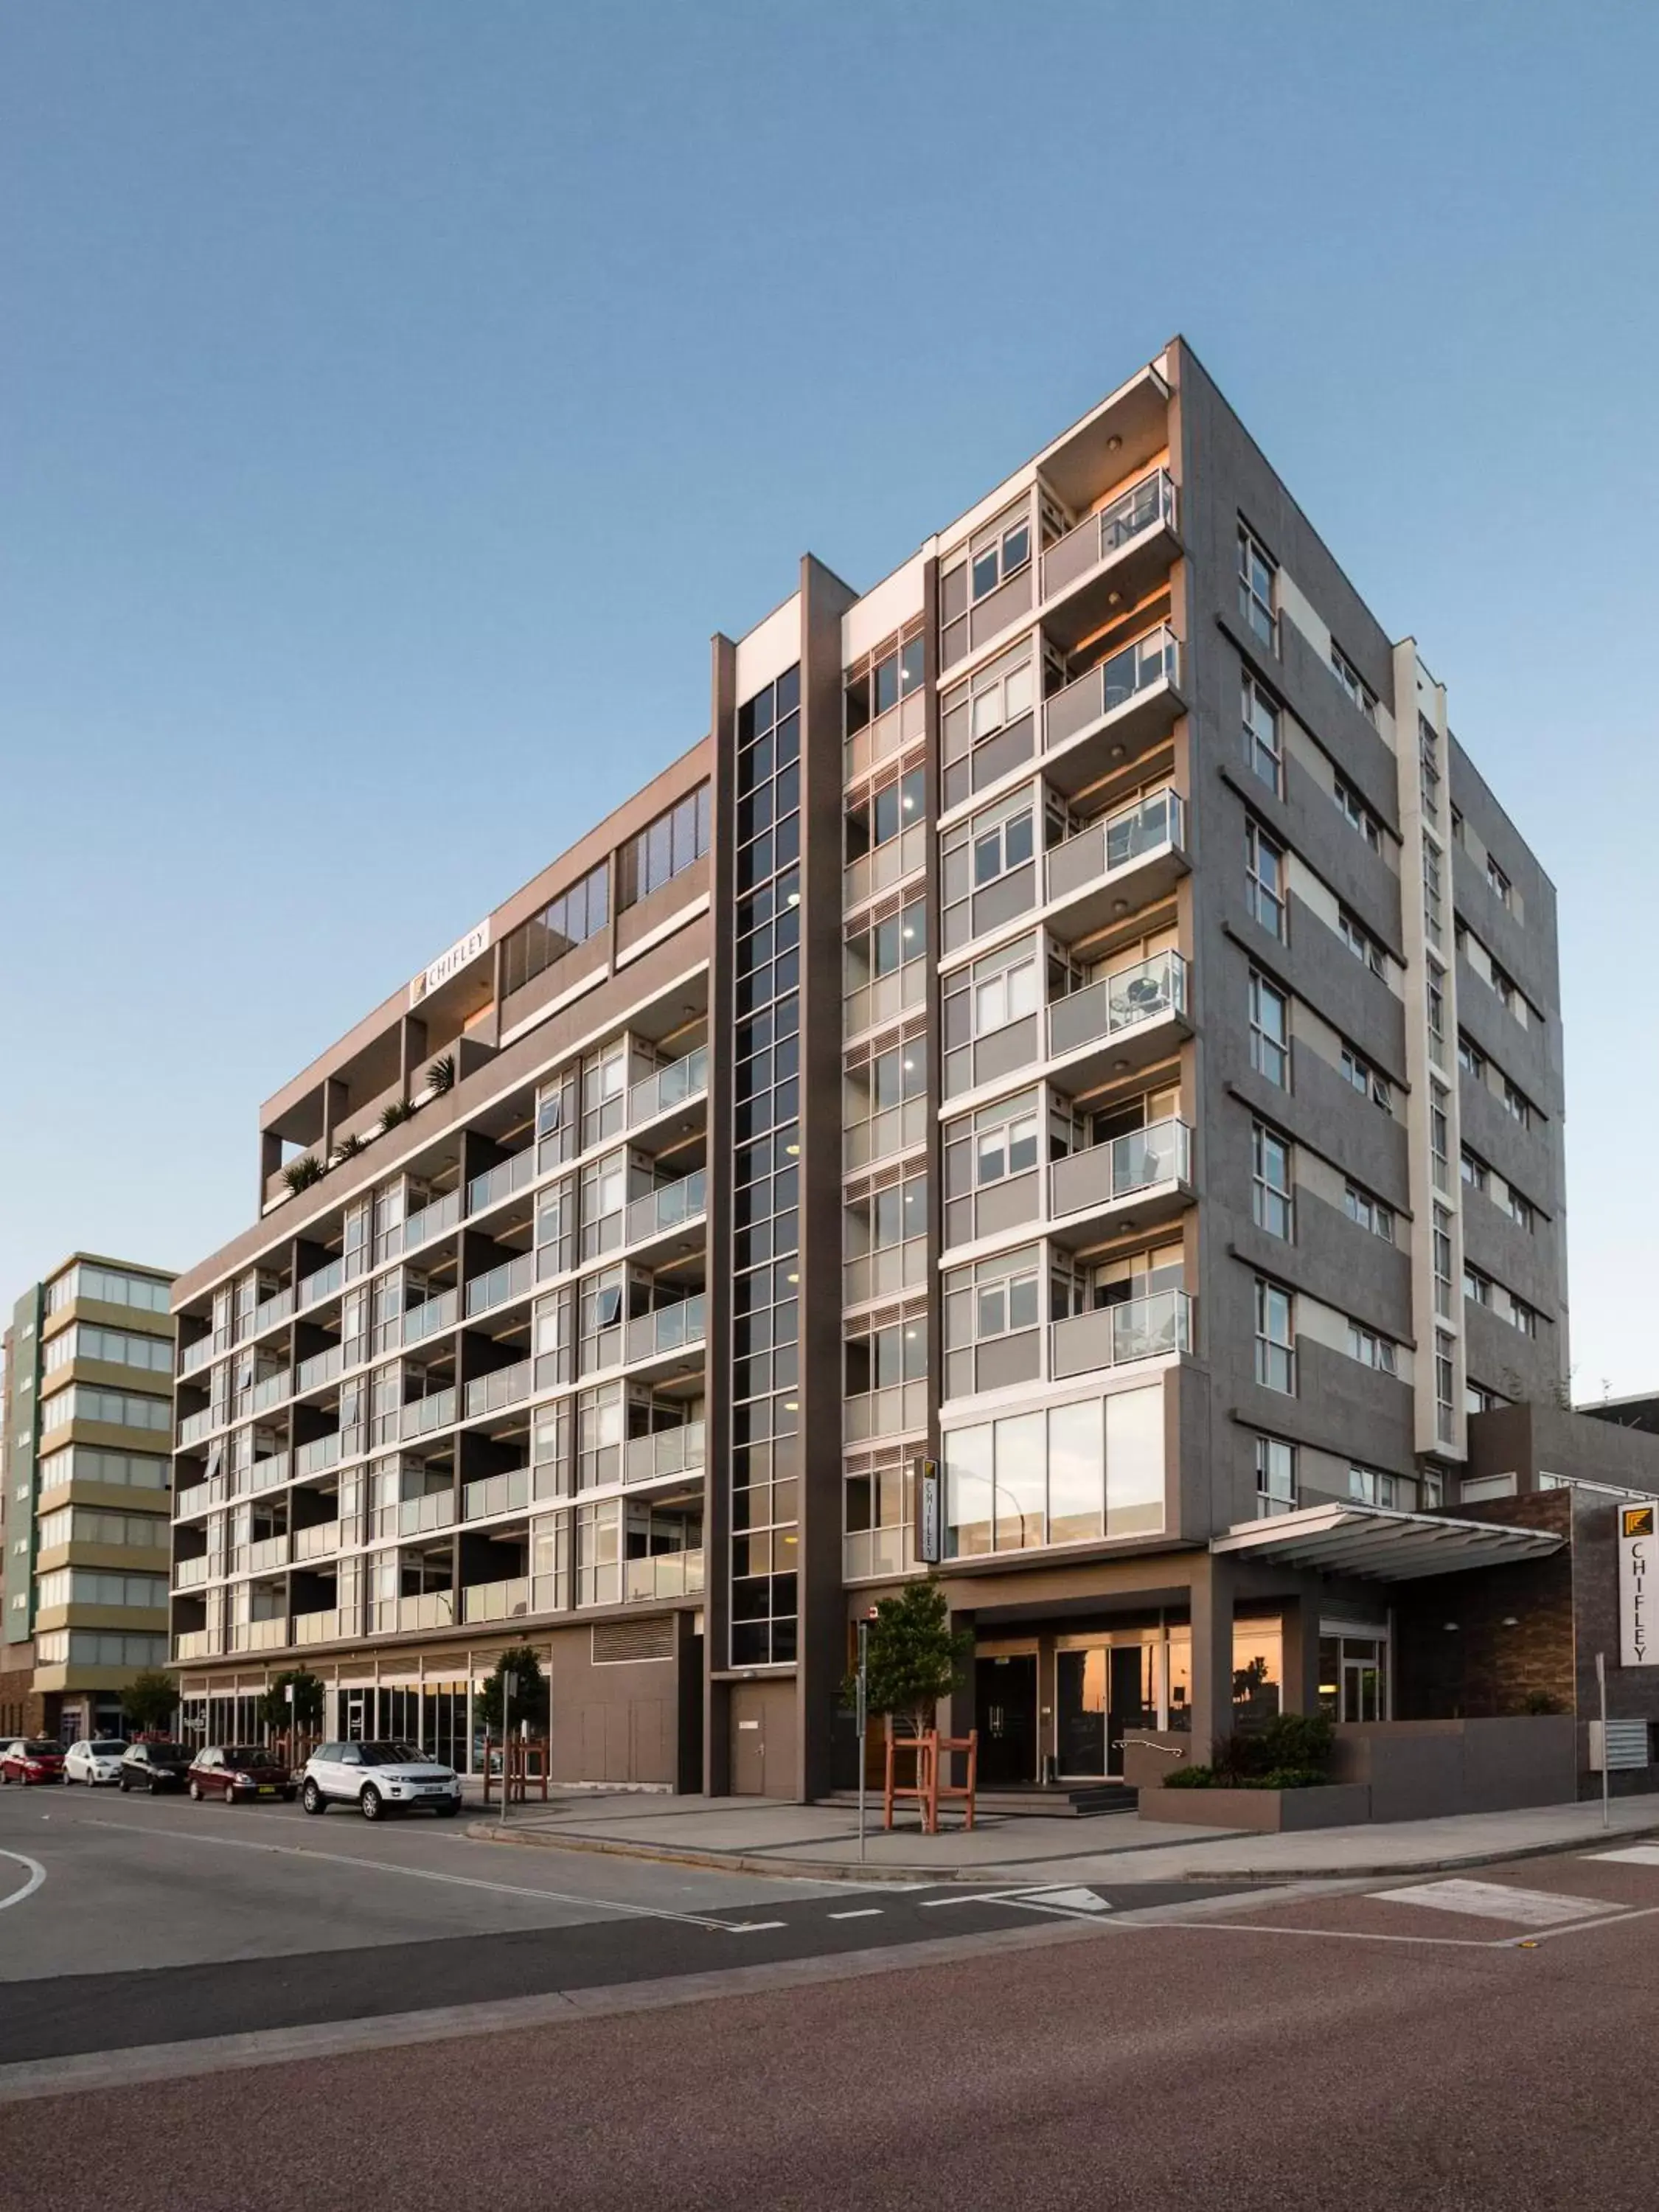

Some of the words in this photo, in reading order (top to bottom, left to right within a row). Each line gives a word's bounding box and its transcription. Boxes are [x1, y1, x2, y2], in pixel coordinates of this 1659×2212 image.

[429, 931, 484, 985] CHIFLEY
[925, 1483, 933, 1556] CHIFLEY
[1632, 1543, 1646, 1662] CHIFLEY
